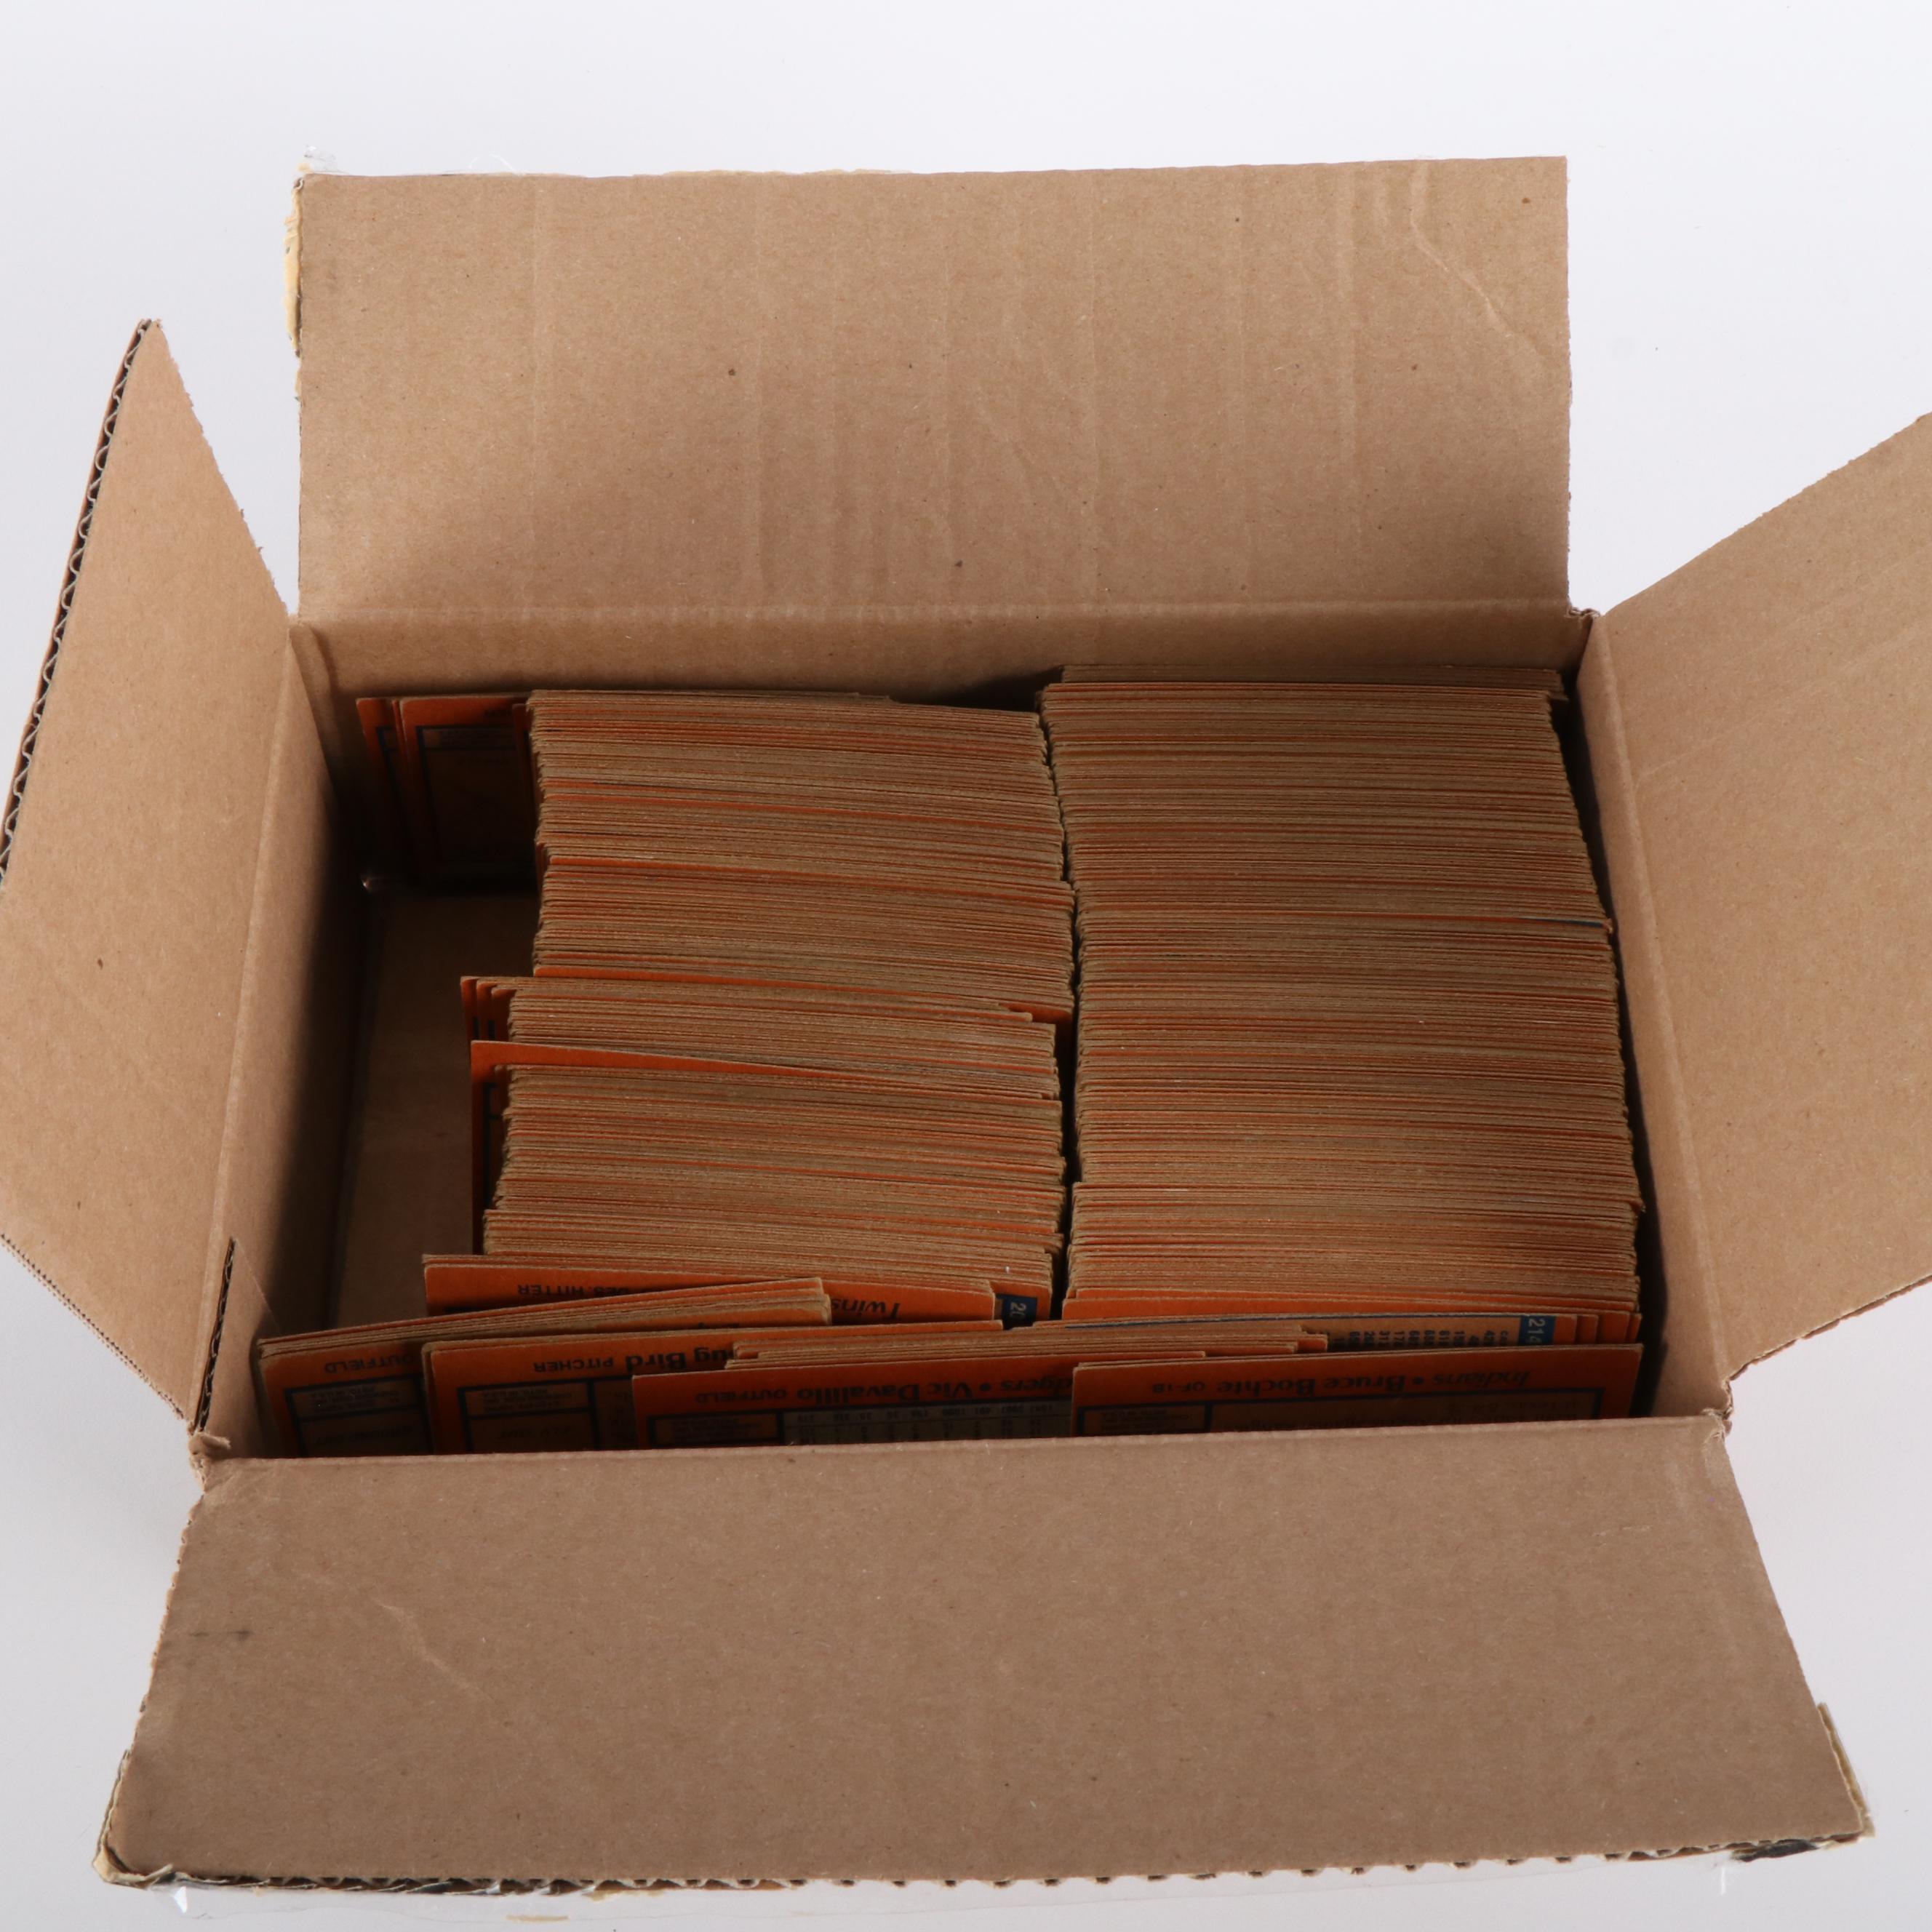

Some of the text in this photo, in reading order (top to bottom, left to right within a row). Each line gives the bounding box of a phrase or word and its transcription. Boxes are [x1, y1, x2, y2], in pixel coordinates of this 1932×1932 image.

[517, 1284, 584, 1297] HITTER
[831, 1298, 901, 1320] Twins
[1525, 1317, 1546, 1346] 214
[324, 1354, 414, 1374] OUTFIELD
[532, 1347, 733, 1373] ug Bird PITCHER
[695, 1375, 1072, 1408] dgers Vic Davalillo OUTFIELD
[1151, 1371, 1530, 1398] Indians Bruce Bochte OF-1B
